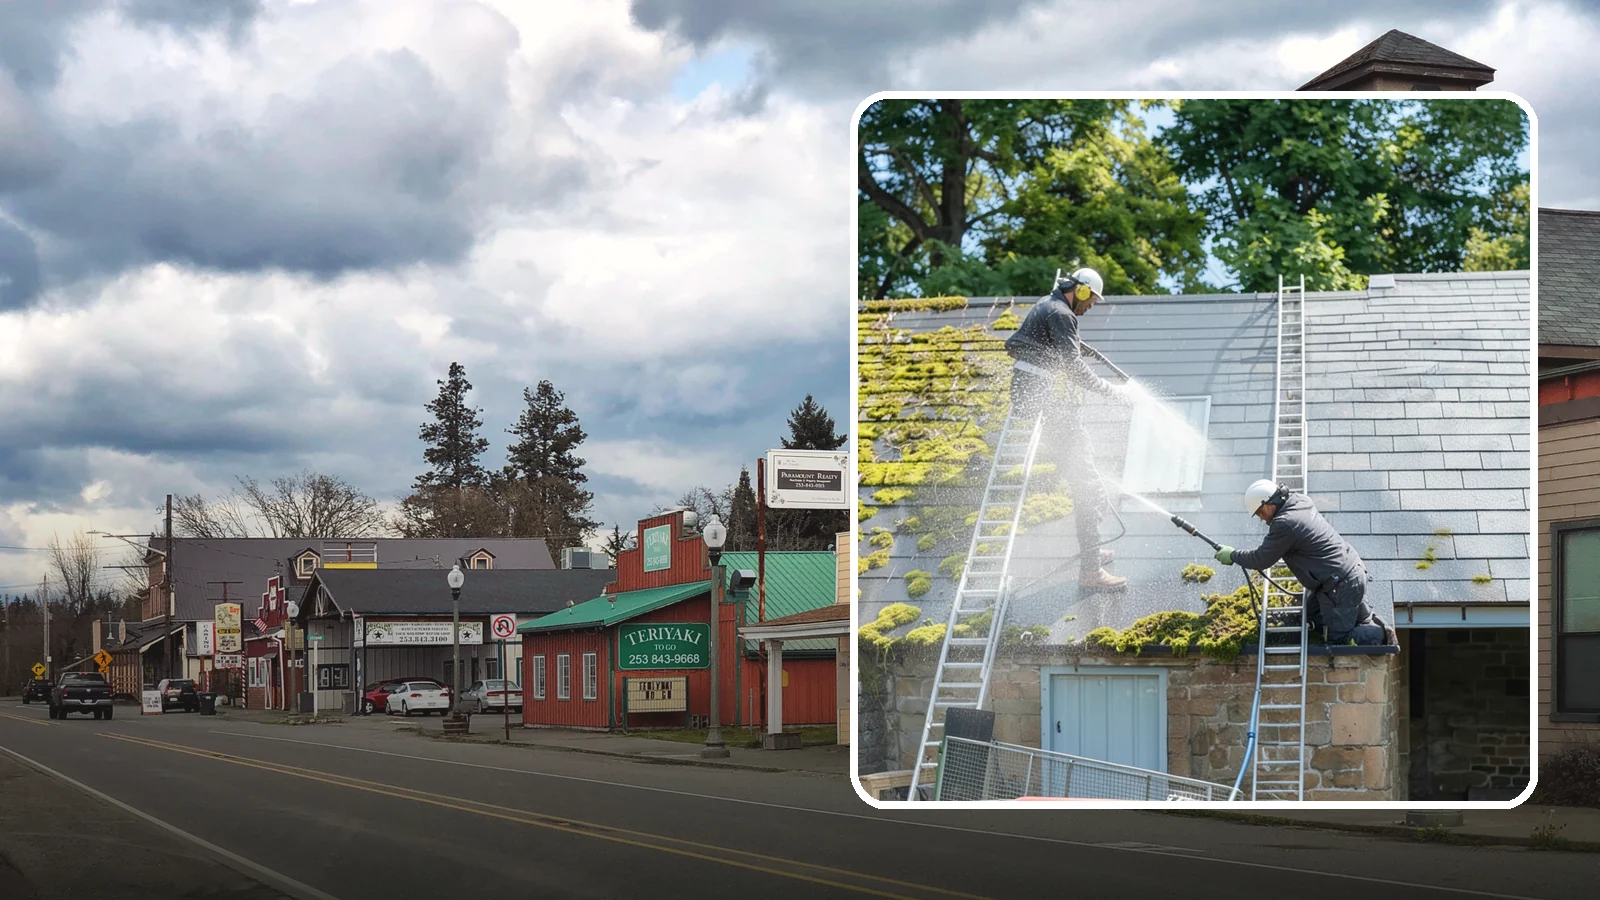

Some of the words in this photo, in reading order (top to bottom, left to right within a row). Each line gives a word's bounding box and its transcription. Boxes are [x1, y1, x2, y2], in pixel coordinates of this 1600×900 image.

[781, 471, 815, 479] PARAMOUNT
[817, 472, 839, 480] REALTY
[625, 627, 702, 646] TERIYAKI
[654, 643, 665, 651] TO
[665, 643, 677, 651] GO
[629, 654, 649, 665] 253
[651, 653, 700, 664] 843-9668
